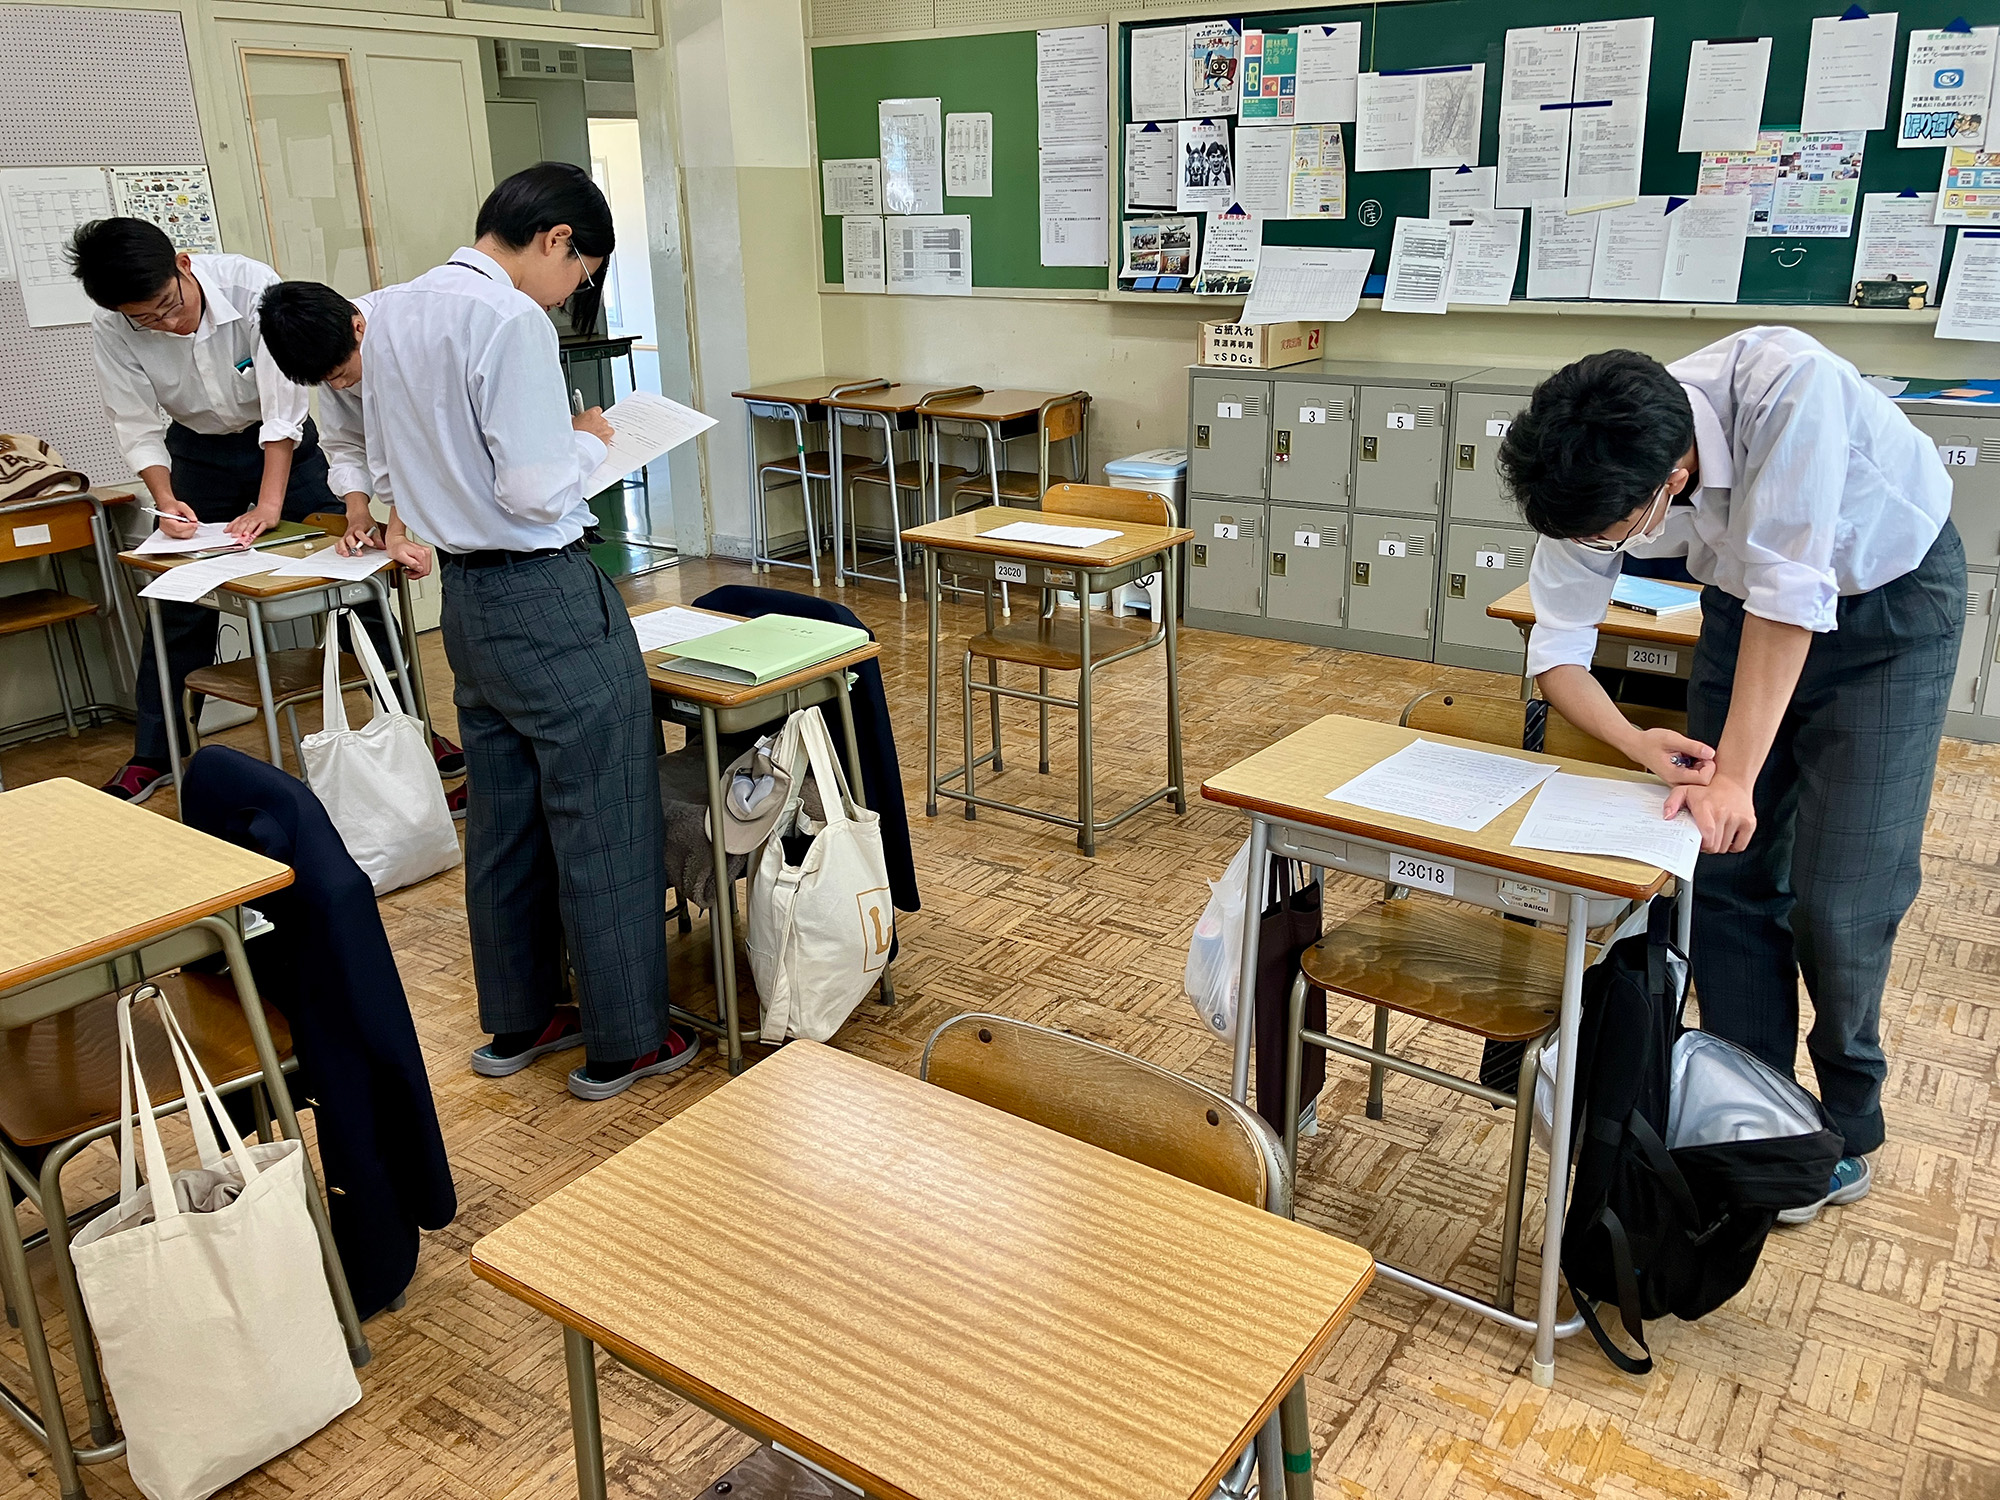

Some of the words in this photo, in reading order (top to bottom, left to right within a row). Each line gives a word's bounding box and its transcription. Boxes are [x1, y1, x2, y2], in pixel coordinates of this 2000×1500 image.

[1227, 406, 1231, 418] 1
[1308, 411, 1316, 423] 3
[1396, 417, 1404, 429] 5
[1497, 424, 1504, 436] 7
[1947, 450, 1967, 465] 15
[1222, 527, 1229, 538] 2
[1303, 535, 1310, 547] 4
[1388, 545, 1396, 556] 6
[1486, 555, 1494, 567] 8
[998, 565, 1022, 578] 23C20
[1633, 650, 1669, 666] 23C11
[1397, 860, 1446, 884] 23C18
[868, 906, 893, 955] L
